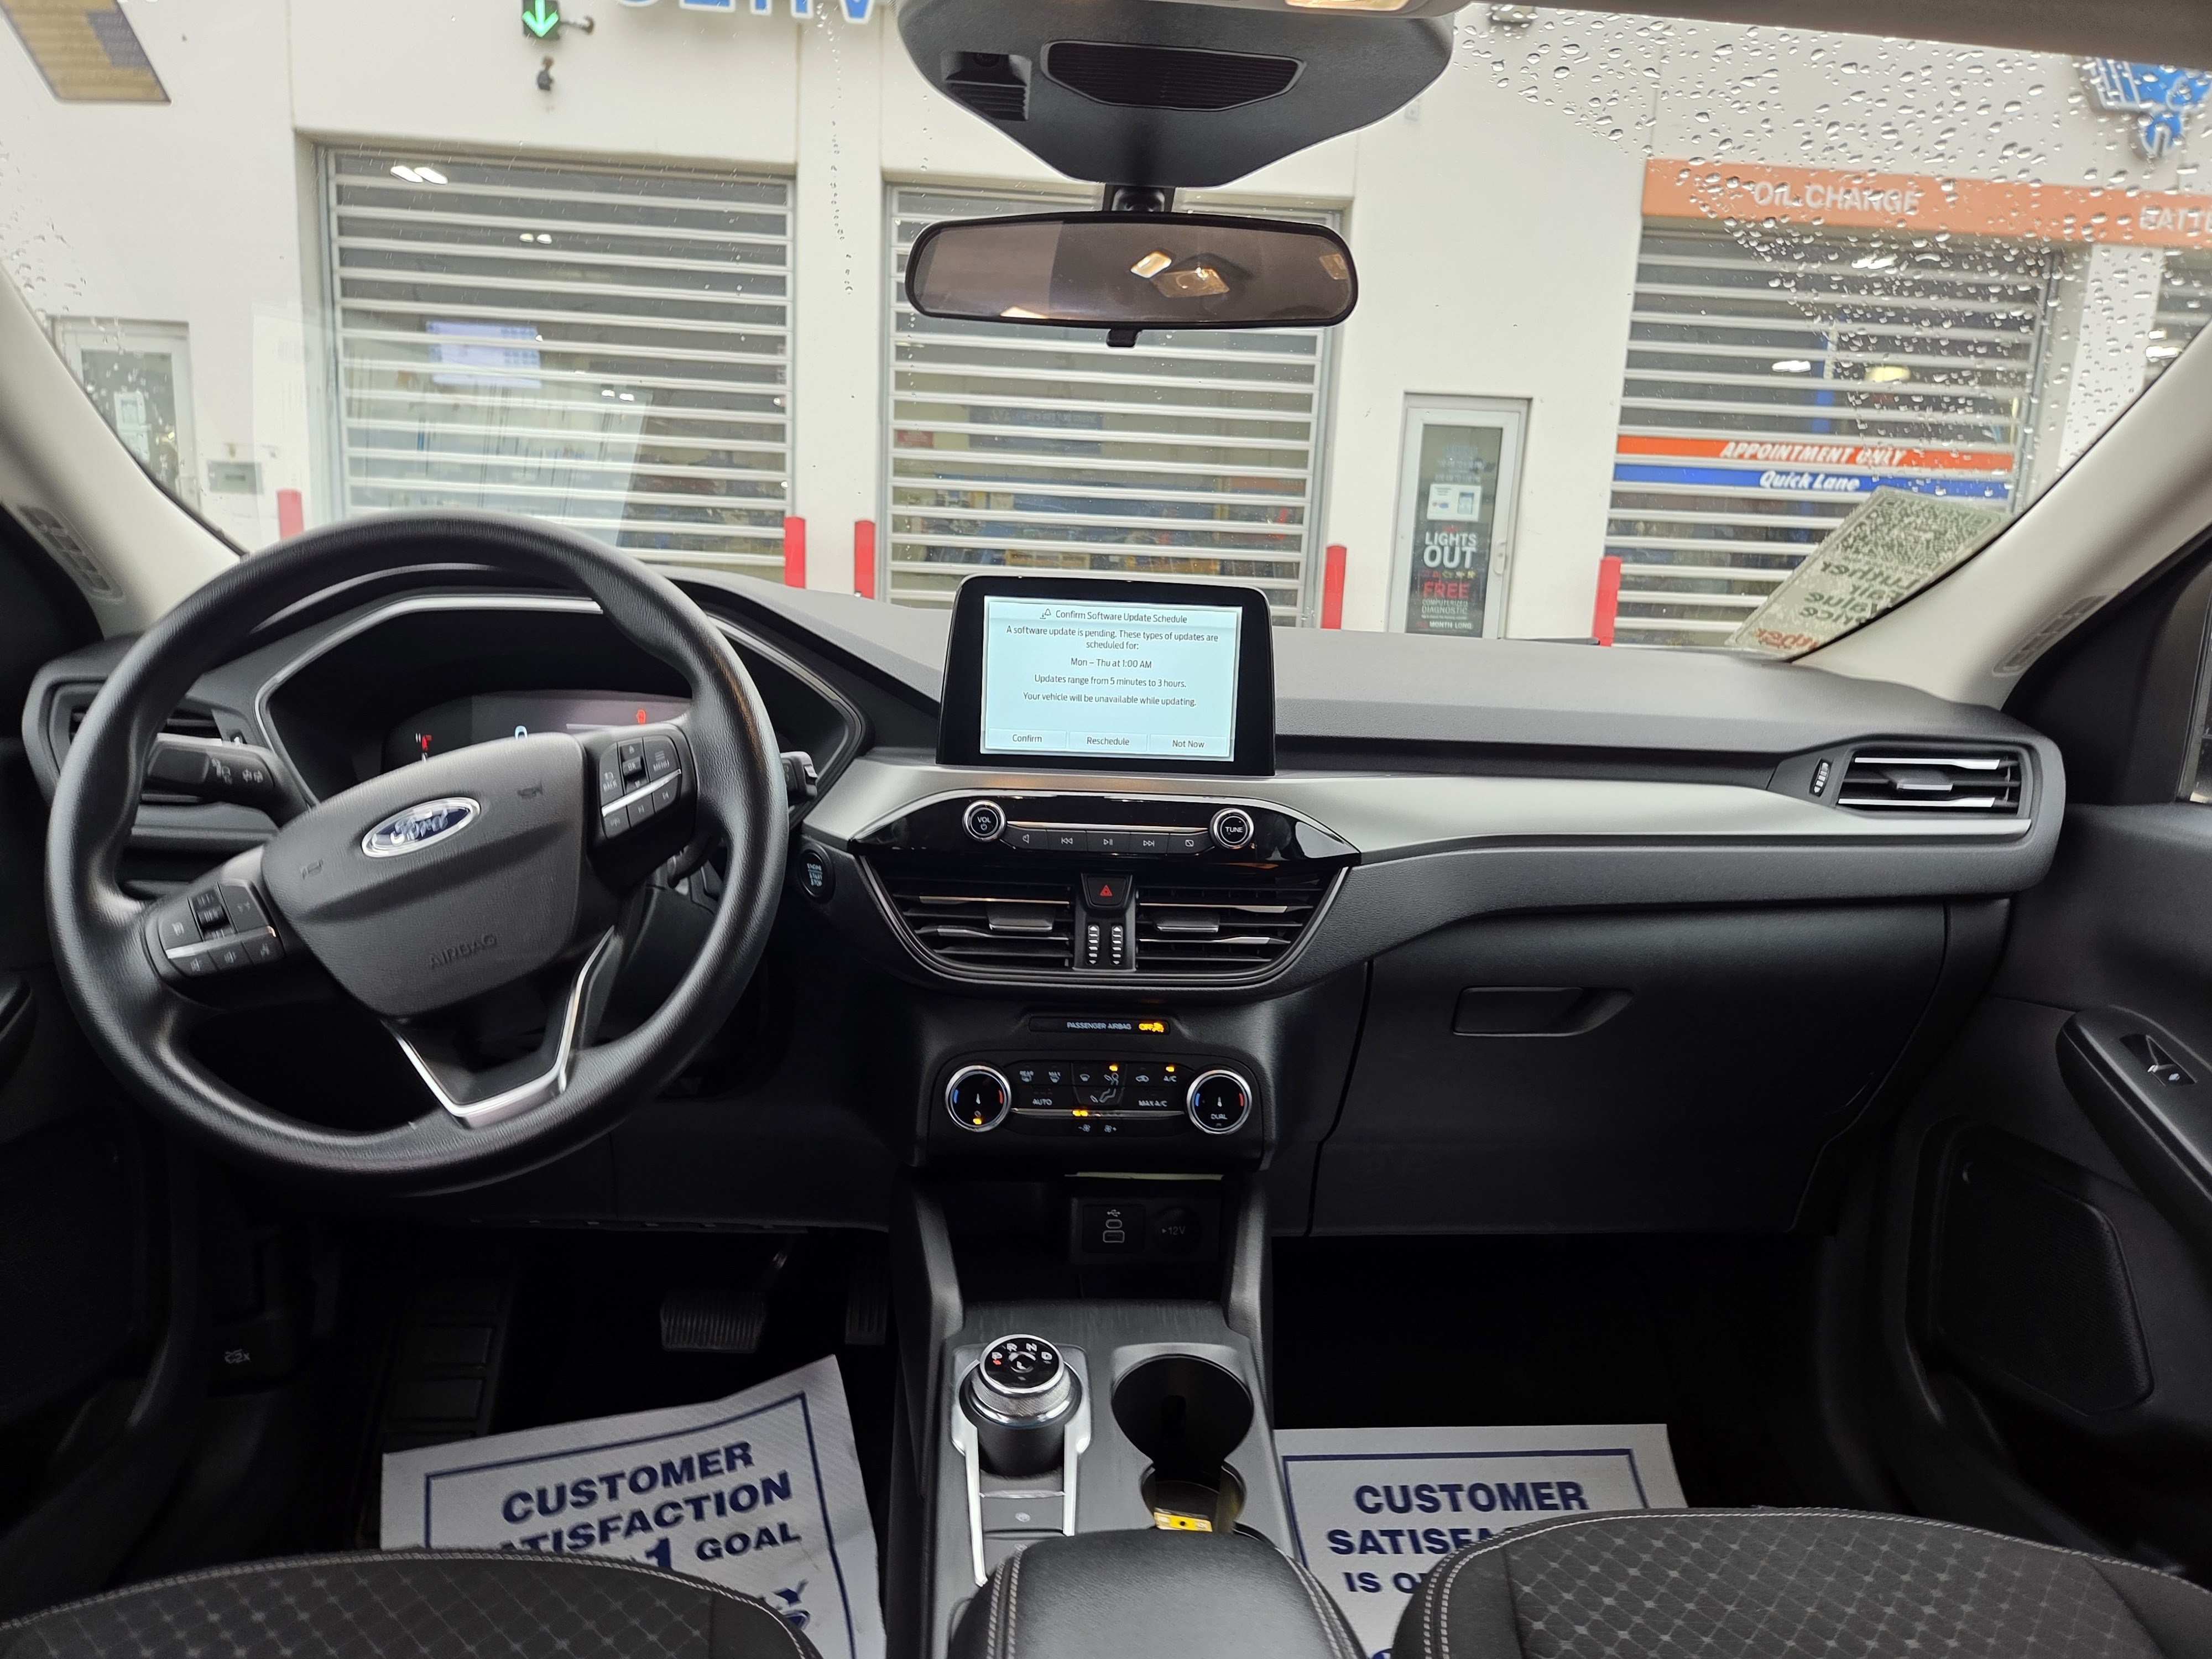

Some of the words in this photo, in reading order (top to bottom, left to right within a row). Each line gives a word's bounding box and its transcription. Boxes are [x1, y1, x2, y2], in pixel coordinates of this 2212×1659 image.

[1754, 181, 1797, 206] OIL
[1806, 184, 1919, 215] CHANGE
[1720, 441, 1854, 465] APPOINTMENT
[1856, 447, 1907, 467] ONLY
[1760, 470, 1813, 489] Quick
[1813, 473, 1860, 491] Lane
[1425, 531, 1477, 546] LIGHTS
[1423, 545, 1477, 568] OUT
[1423, 581, 1469, 599] FREE
[1056, 610, 1086, 619] Confirm
[1087, 612, 1122, 620] Software
[1124, 613, 1151, 622] Update
[1153, 614, 1187, 623] Schedule
[1422, 606, 1468, 614] DIAGNOSTIC
[1006, 625, 1012, 634] A
[1014, 625, 1047, 635] software
[1049, 627, 1076, 637] update
[1085, 629, 1117, 639] pending.
[1119, 630, 1141, 638] These
[1143, 632, 1163, 640] types
[1165, 632, 1172, 640] of
[1174, 633, 1204, 641] updates
[1086, 640, 1124, 649] scheduled
[1071, 658, 1087, 666] Mon
[1096, 659, 1110, 667] Thu
[1139, 660, 1152, 669] AM
[1035, 674, 1066, 684] Updates
[1068, 677, 1089, 685] range
[1091, 676, 1109, 685] from
[1117, 677, 1146, 686] minutes
[1023, 692, 1041, 700] Your
[1042, 693, 1068, 701] vehicle
[1084, 694, 1093, 702] be
[1095, 695, 1138, 703] unavailable
[1140, 696, 1160, 705] while
[1161, 697, 1197, 707] updating.
[1012, 734, 1042, 743] Confirm
[1087, 737, 1130, 745] Reschedule
[1172, 739, 1186, 748] Not
[1188, 740, 1205, 748] Now
[653, 759, 670, 772] MENU
[603, 779, 617, 791] BACK
[390, 805, 448, 846] Ford
[811, 878, 822, 886] STOP
[429, 933, 497, 969] AIRBAG
[1168, 1225, 1186, 1235] 12V
[1006, 1343, 1018, 1352] R
[1026, 1343, 1037, 1352] N
[1041, 1352, 1052, 1360] D
[502, 1441, 755, 1525] CUSTOMER
[1354, 1481, 1590, 1515] CUSTOMER
[499, 1472, 793, 1552] TISFACTION
[695, 1521, 802, 1562] GOAL
[1342, 1572, 1383, 1593] IS
[1392, 1572, 1428, 1594] O
